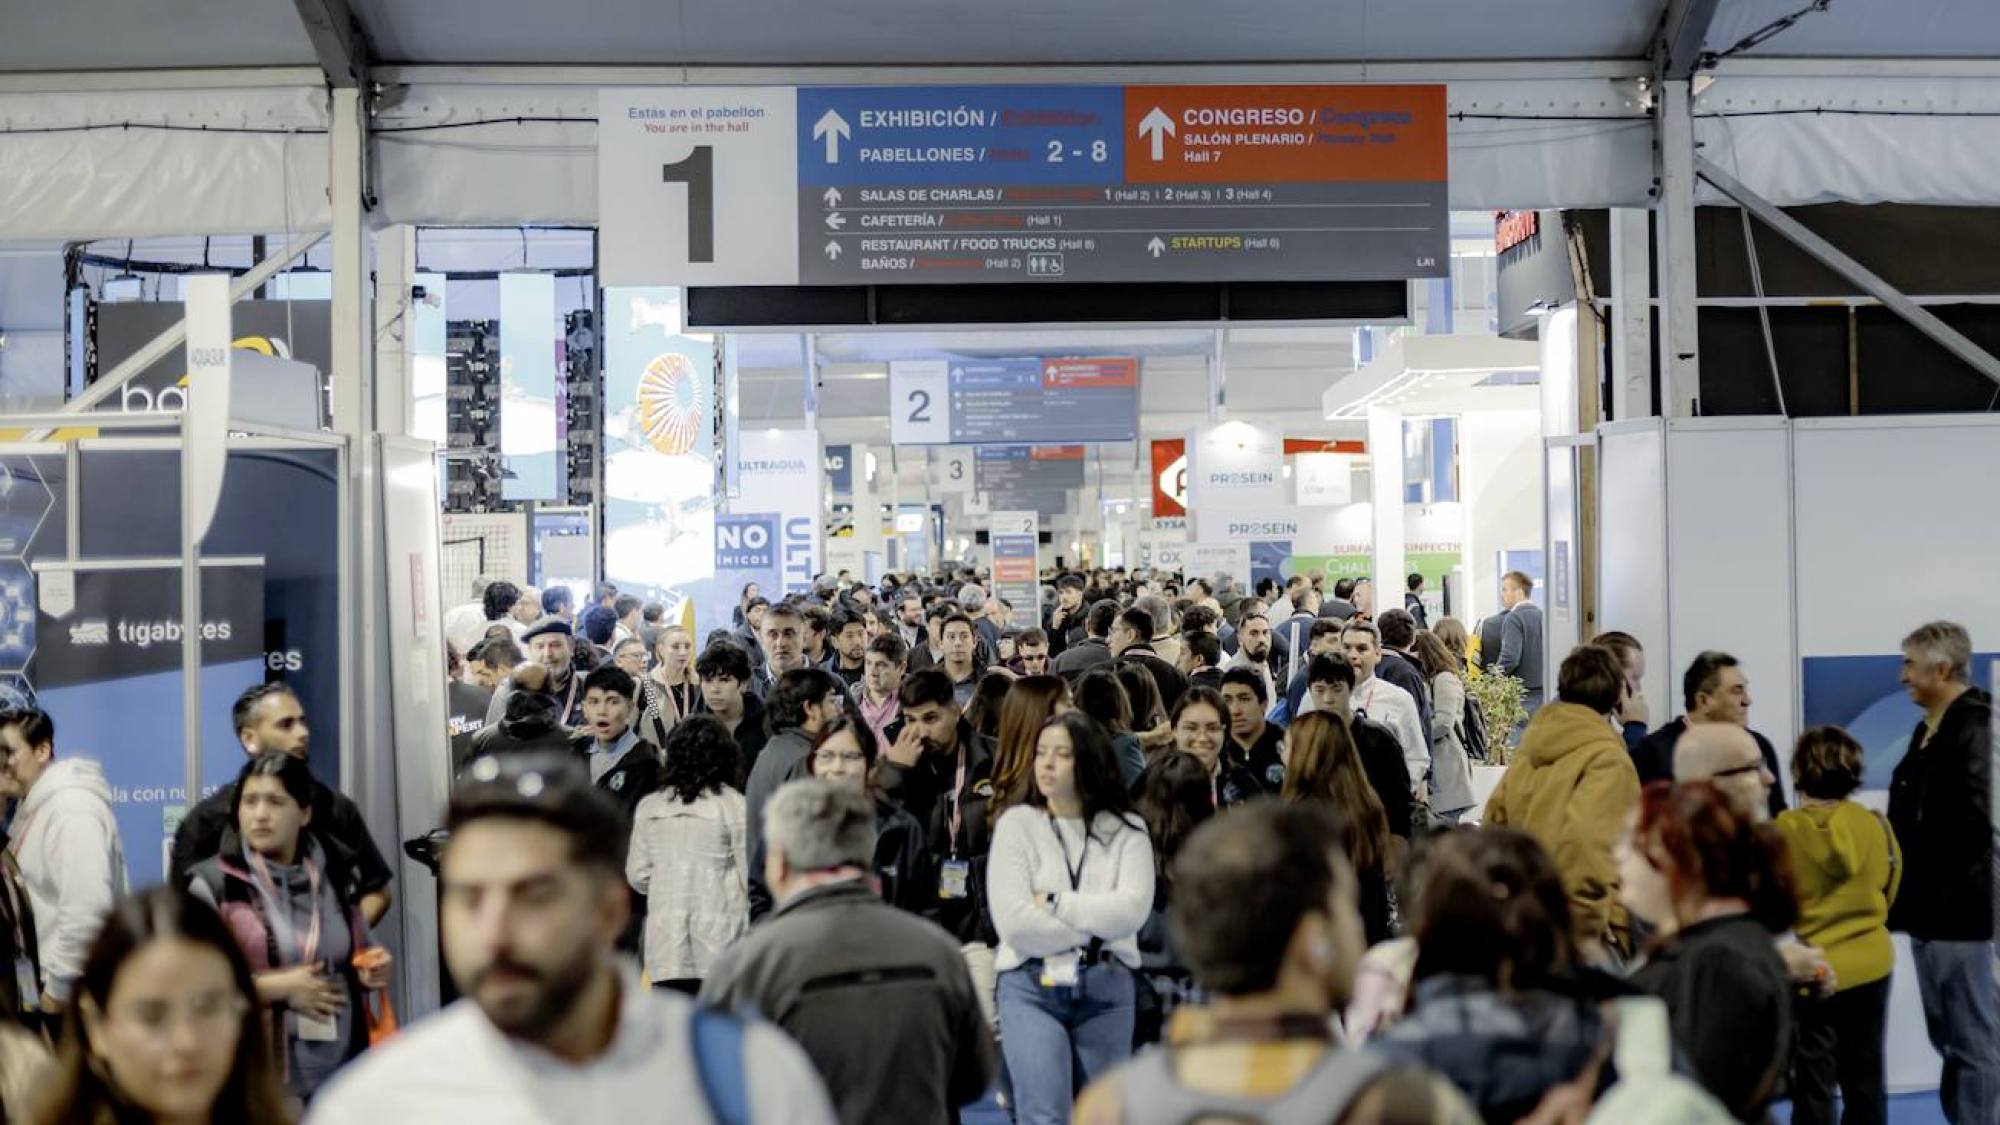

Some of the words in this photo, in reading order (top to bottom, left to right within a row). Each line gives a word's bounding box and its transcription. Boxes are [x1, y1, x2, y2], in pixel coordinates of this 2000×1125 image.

[628, 106, 665, 119] Estás
[668, 110, 686, 119] en
[690, 106, 702, 119] el
[706, 106, 765, 121] pabellón
[860, 106, 985, 128] EXHIBICIÓN
[990, 111, 997, 128] /
[1184, 109, 1304, 126] CONGRESO
[644, 123, 662, 133] You
[664, 125, 682, 133] are
[690, 123, 702, 133] in
[705, 123, 723, 133] the
[726, 122, 749, 133] hall
[1184, 131, 1231, 146] SALÓN
[1235, 133, 1304, 146] PLENARIO
[860, 148, 975, 162] PABELLONES
[1047, 140, 1064, 162] 2
[1091, 140, 1108, 162] 8
[1184, 150, 1210, 162] Hall
[1213, 151, 1221, 162] 7
[861, 190, 909, 202] SALAS
[911, 190, 927, 201] DE
[930, 189, 994, 201] CHARLAS
[1104, 189, 1112, 200] 1
[1115, 190, 1138, 202] (Hall
[1164, 188, 1174, 200] 2
[1175, 190, 1198, 201] (Hall
[1225, 188, 1235, 200] 3
[1236, 189, 1259, 201] (Hall
[663, 146, 715, 263] 1
[861, 212, 936, 226] CAFETERÍA
[1027, 215, 1048, 227] (Hall
[861, 239, 950, 251] RESTAURANT
[961, 239, 998, 250] FOOD
[1002, 238, 1056, 250] TRUCKS
[1059, 239, 1080, 251] (Hall
[1171, 237, 1241, 249] STARTUPS
[1244, 238, 1267, 250] (Hall
[861, 255, 908, 269] BAÑOS
[985, 259, 1007, 271] (Hall
[907, 389, 931, 423] 2
[949, 460, 963, 480] 3
[717, 524, 768, 550] NO
[132, 788, 164, 802] con
